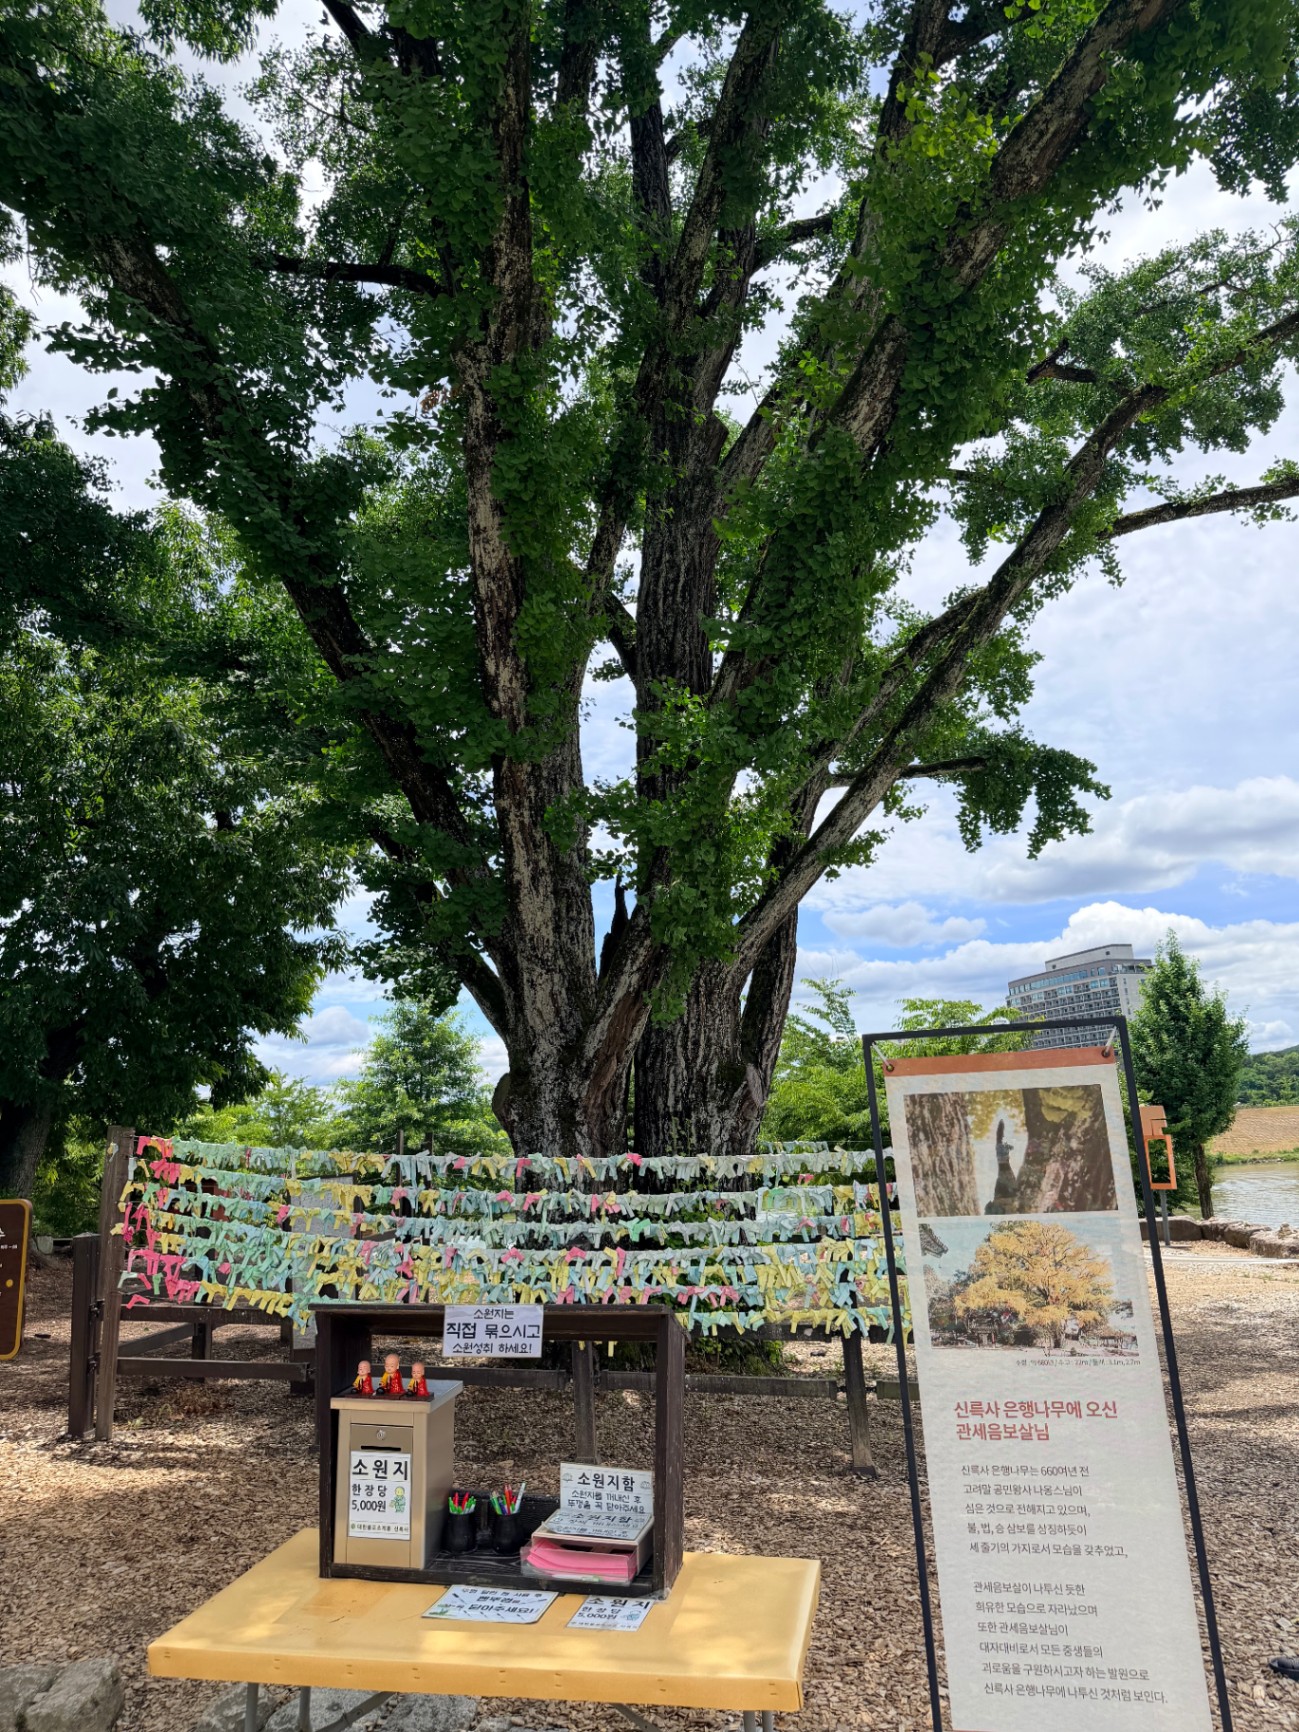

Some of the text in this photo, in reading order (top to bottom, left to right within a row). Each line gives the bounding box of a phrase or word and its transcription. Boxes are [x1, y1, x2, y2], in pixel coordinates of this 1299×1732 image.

[474, 1308, 515, 1320] 소원지는
[446, 1322, 541, 1339] 직접 묶으시고
[452, 1342, 532, 1354] 소원성취 하세요!
[954, 1400, 1118, 1419] 신륵사 은행나무에 오신
[956, 1422, 1050, 1441] 관세음보살님
[961, 1464, 1090, 1478] 신륵사 은행나무는 660여년 전
[577, 1471, 635, 1492] 소원지함
[571, 1490, 642, 1504] 소원지를 꺼내신 후
[963, 1483, 1082, 1496] 고려말 공민왕사 나옹스님이
[351, 1499, 386, 1513] 5,000원
[567, 1499, 591, 1510] 뚜껑을
[606, 1502, 646, 1514] 닫아주세요
[965, 1503, 1091, 1517] 심은 것으로 전해지고 있으며,
[1007, 1523, 1036, 1535] 삼보를
[1037, 1524, 1088, 1536] 상징하듯이
[1011, 1543, 1051, 1555] 가지로서
[1052, 1544, 1082, 1556] 모습을
[1084, 1545, 1129, 1558] 갖추었고,
[973, 1581, 1086, 1596] 관세음보살이 나투신 듯한
[975, 1601, 1098, 1616] 희유한 모습으로 자라났으며
[977, 1621, 1069, 1636] 또한 관세음보살님이
[979, 1641, 1103, 1658] 대자대비로서 모든 중생들의
[981, 1661, 1150, 1681] 괴로움을 구원하시고자 하는 발원으로
[984, 1682, 1168, 1704] 신륵사 은행나무에 나투신 것처럼 보인다.
